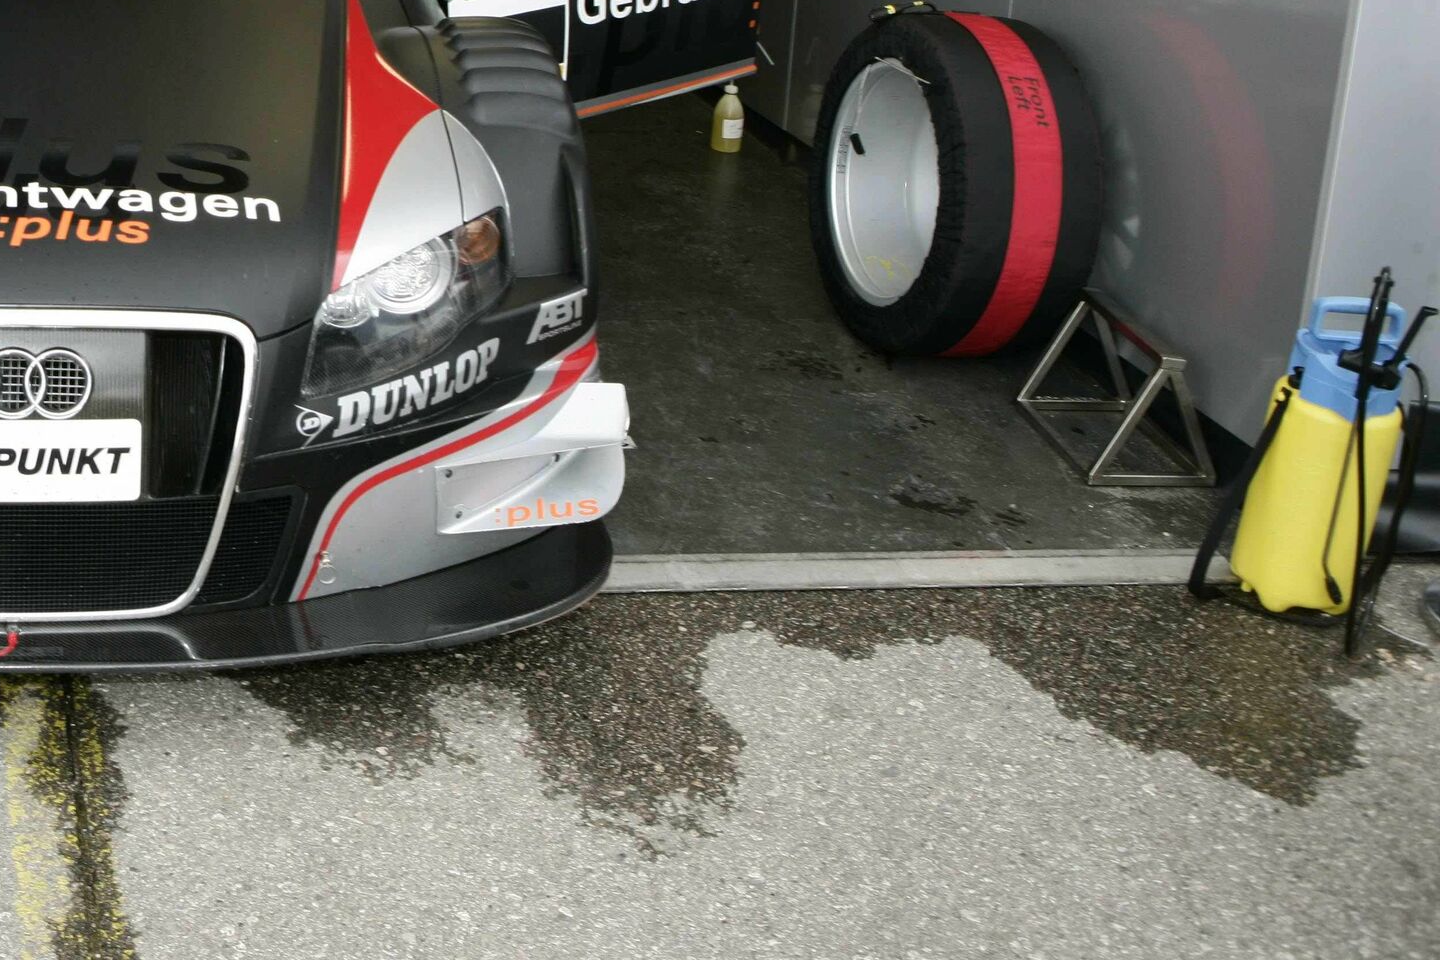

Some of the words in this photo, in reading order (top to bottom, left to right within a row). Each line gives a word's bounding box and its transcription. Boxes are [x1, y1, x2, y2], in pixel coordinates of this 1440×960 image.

[526, 288, 589, 344] ABT
[332, 337, 501, 439] DUNLOP
[495, 498, 601, 527] :plus
